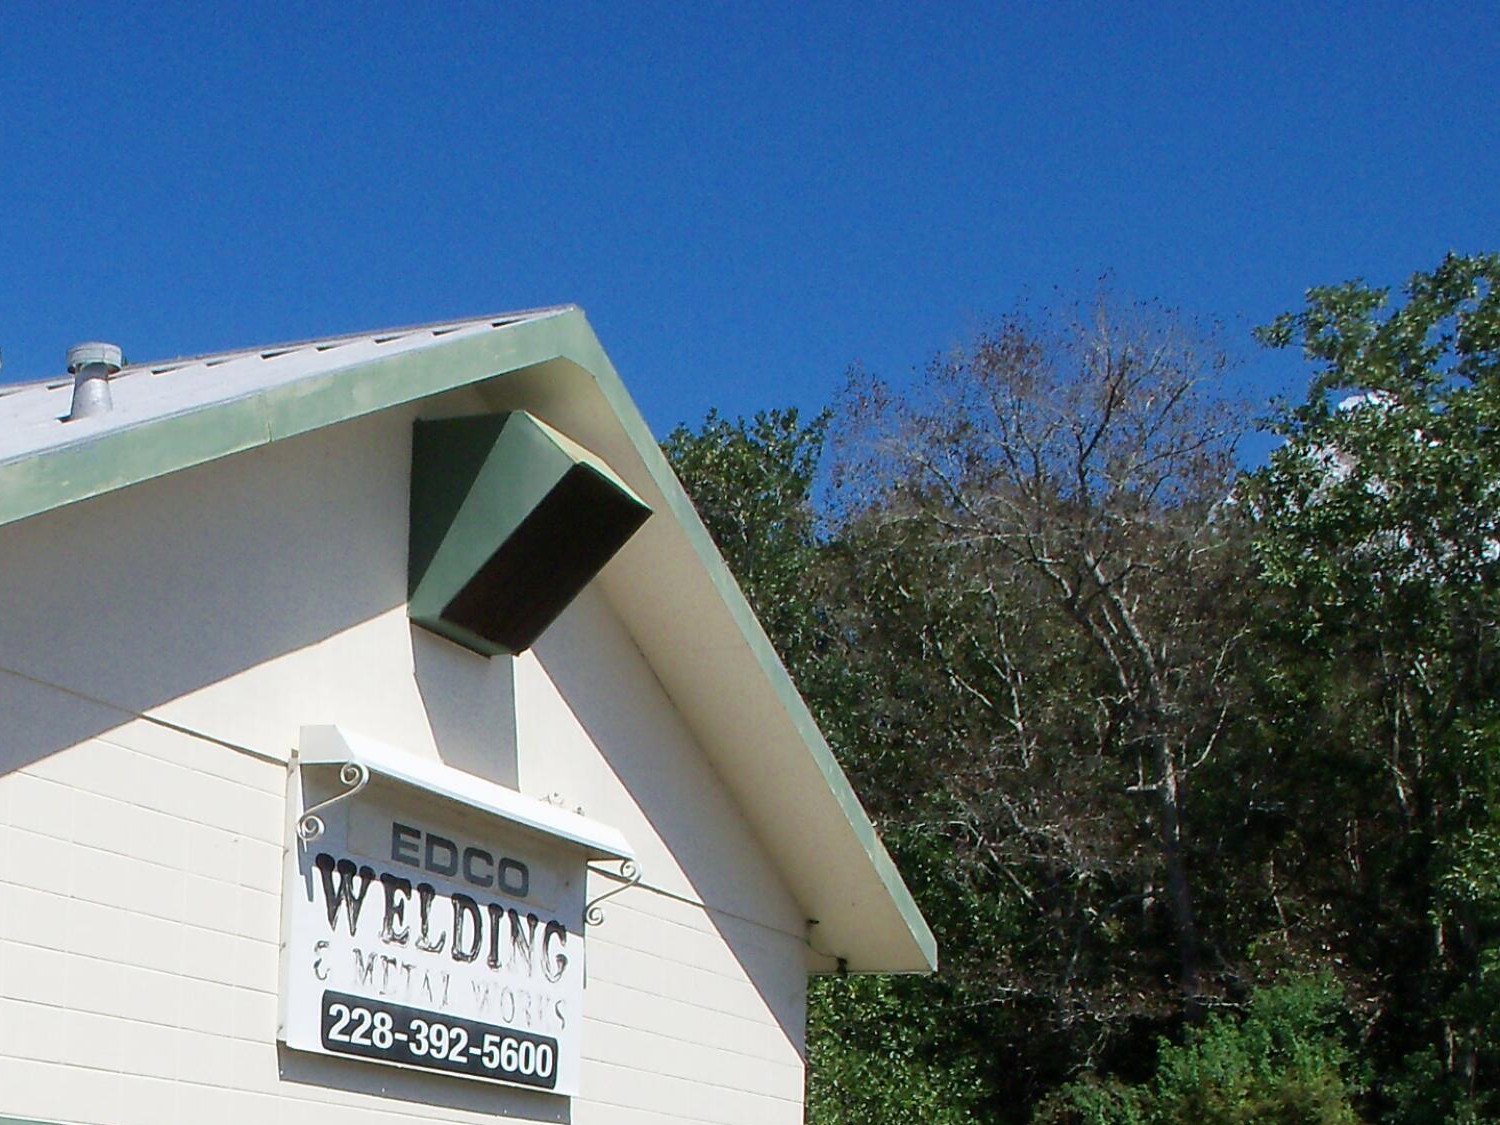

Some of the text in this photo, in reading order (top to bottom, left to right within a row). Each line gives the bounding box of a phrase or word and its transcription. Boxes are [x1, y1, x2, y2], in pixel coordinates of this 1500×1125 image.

[391, 822, 529, 898] EDCO
[315, 853, 567, 983] WELDING
[327, 1003, 554, 1078] 228-392-5600
